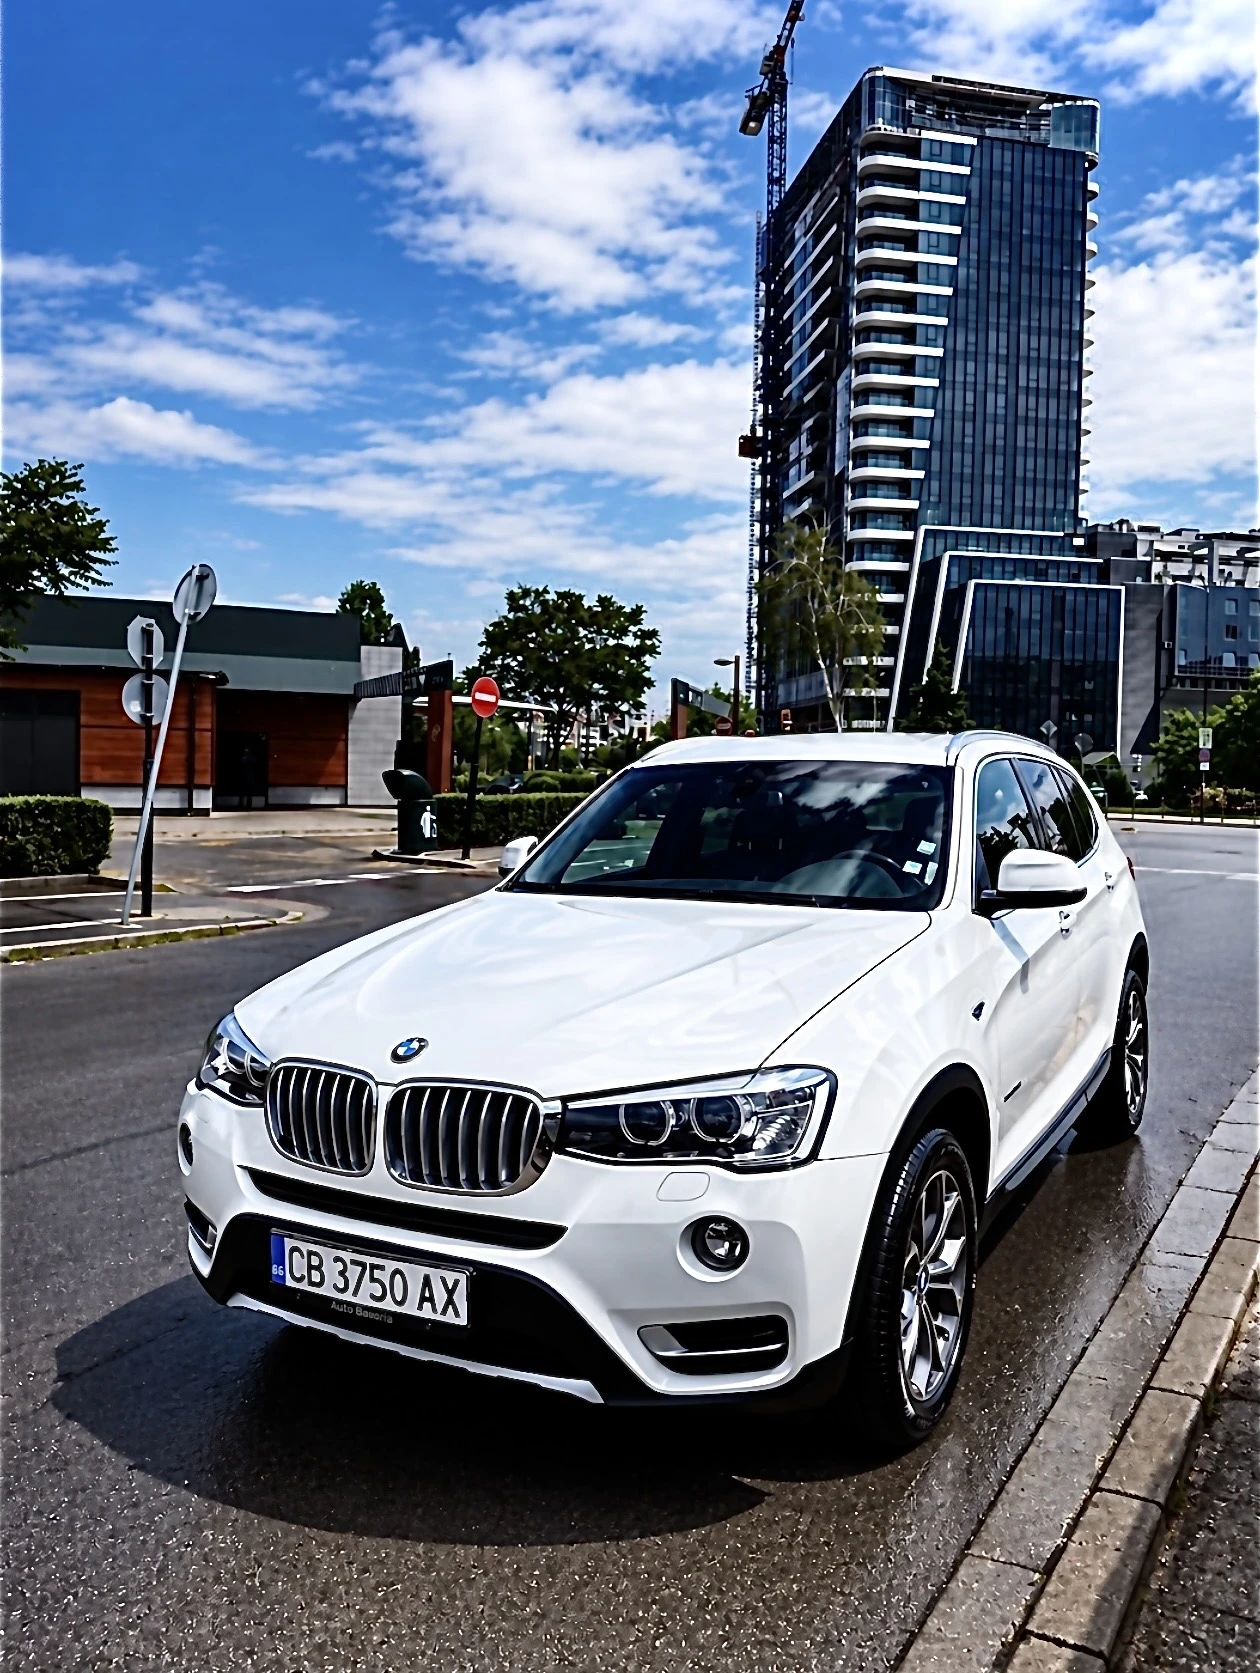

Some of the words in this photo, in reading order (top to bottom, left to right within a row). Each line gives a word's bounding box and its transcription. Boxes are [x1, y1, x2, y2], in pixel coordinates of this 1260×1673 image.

[288, 1245, 326, 1288] CB
[332, 1255, 409, 1307] 3750
[416, 1273, 461, 1319] AX
[331, 1301, 353, 1313] Auto
